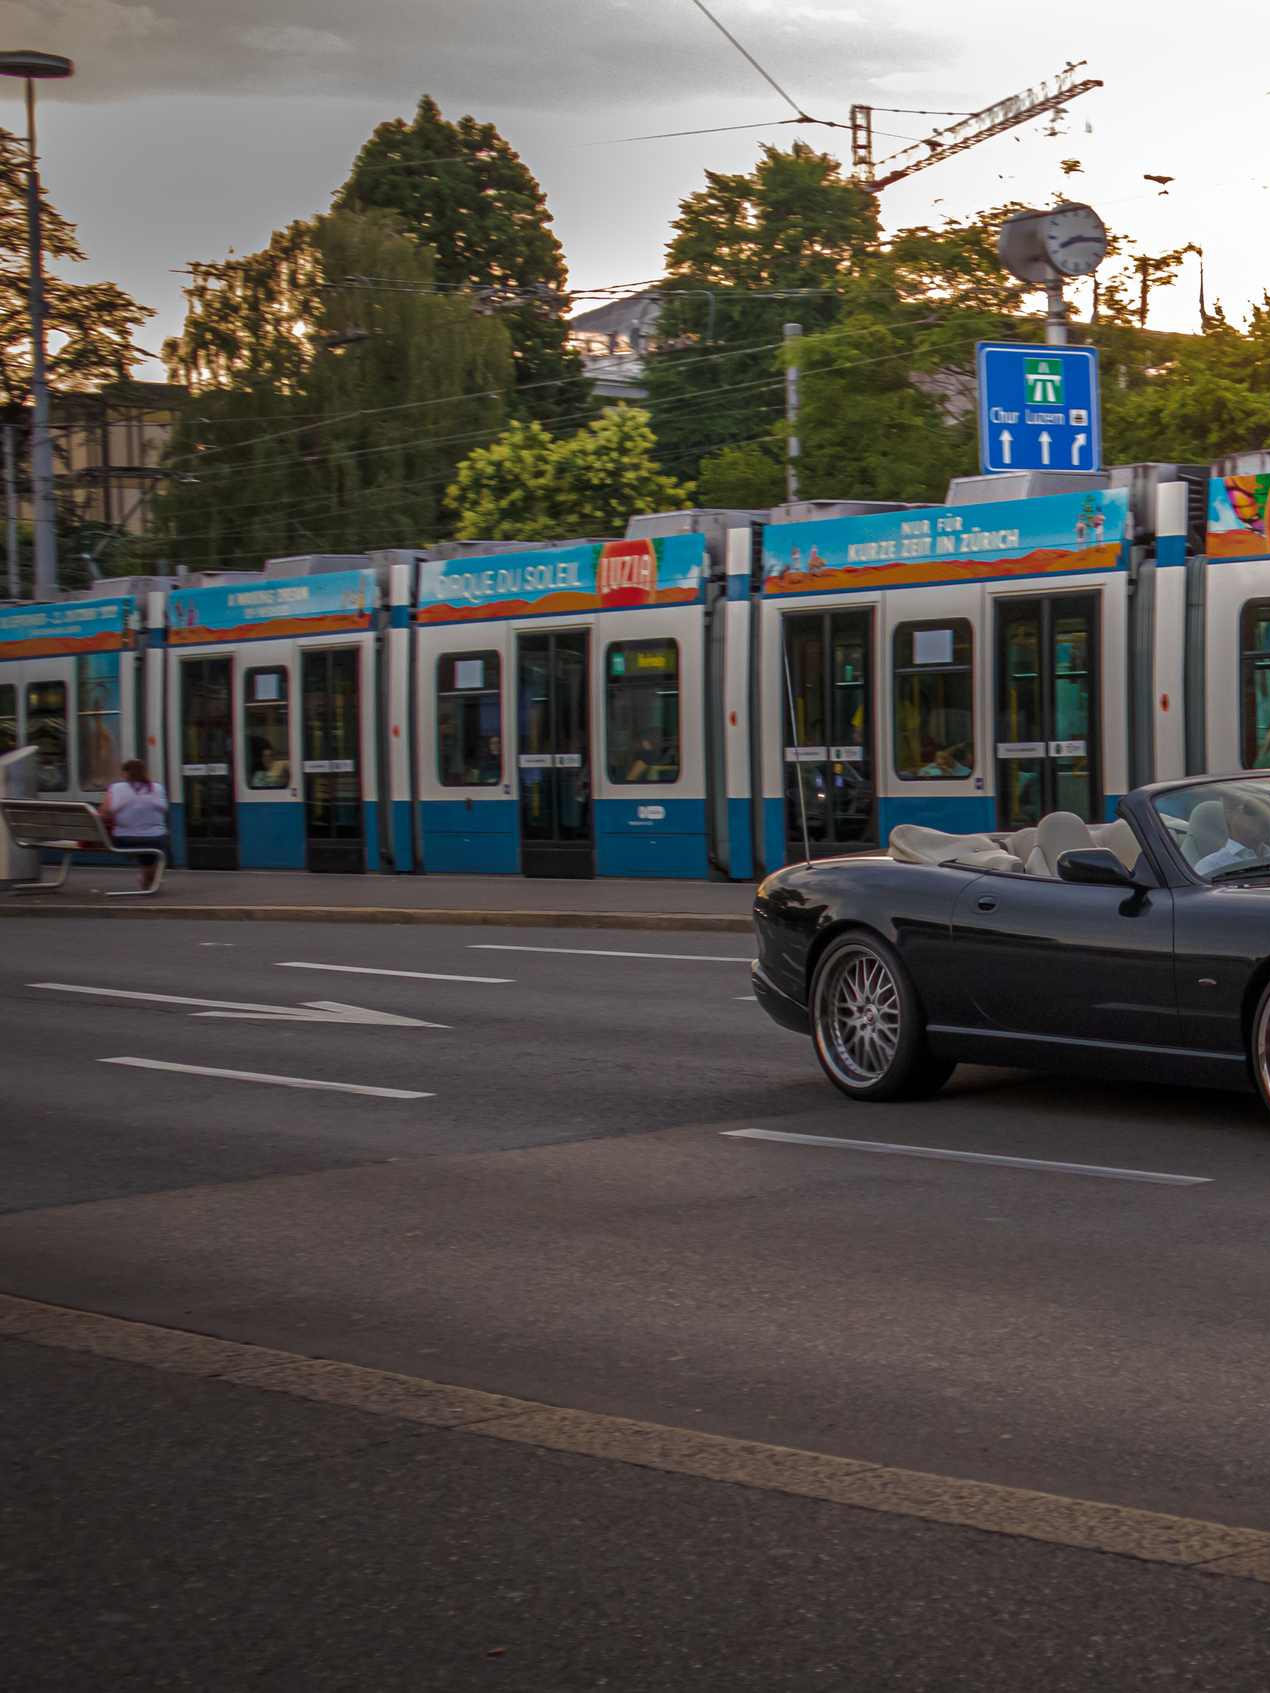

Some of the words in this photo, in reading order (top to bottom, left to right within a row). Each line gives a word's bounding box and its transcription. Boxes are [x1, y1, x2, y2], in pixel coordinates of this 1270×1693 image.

[989, 406, 1020, 424] Chur
[848, 541, 896, 562] KURZE
[901, 537, 933, 557] ZEIT
[936, 535, 956, 554] IN
[960, 527, 1020, 552] ZÜRICH
[601, 554, 651, 595] LUZIA
